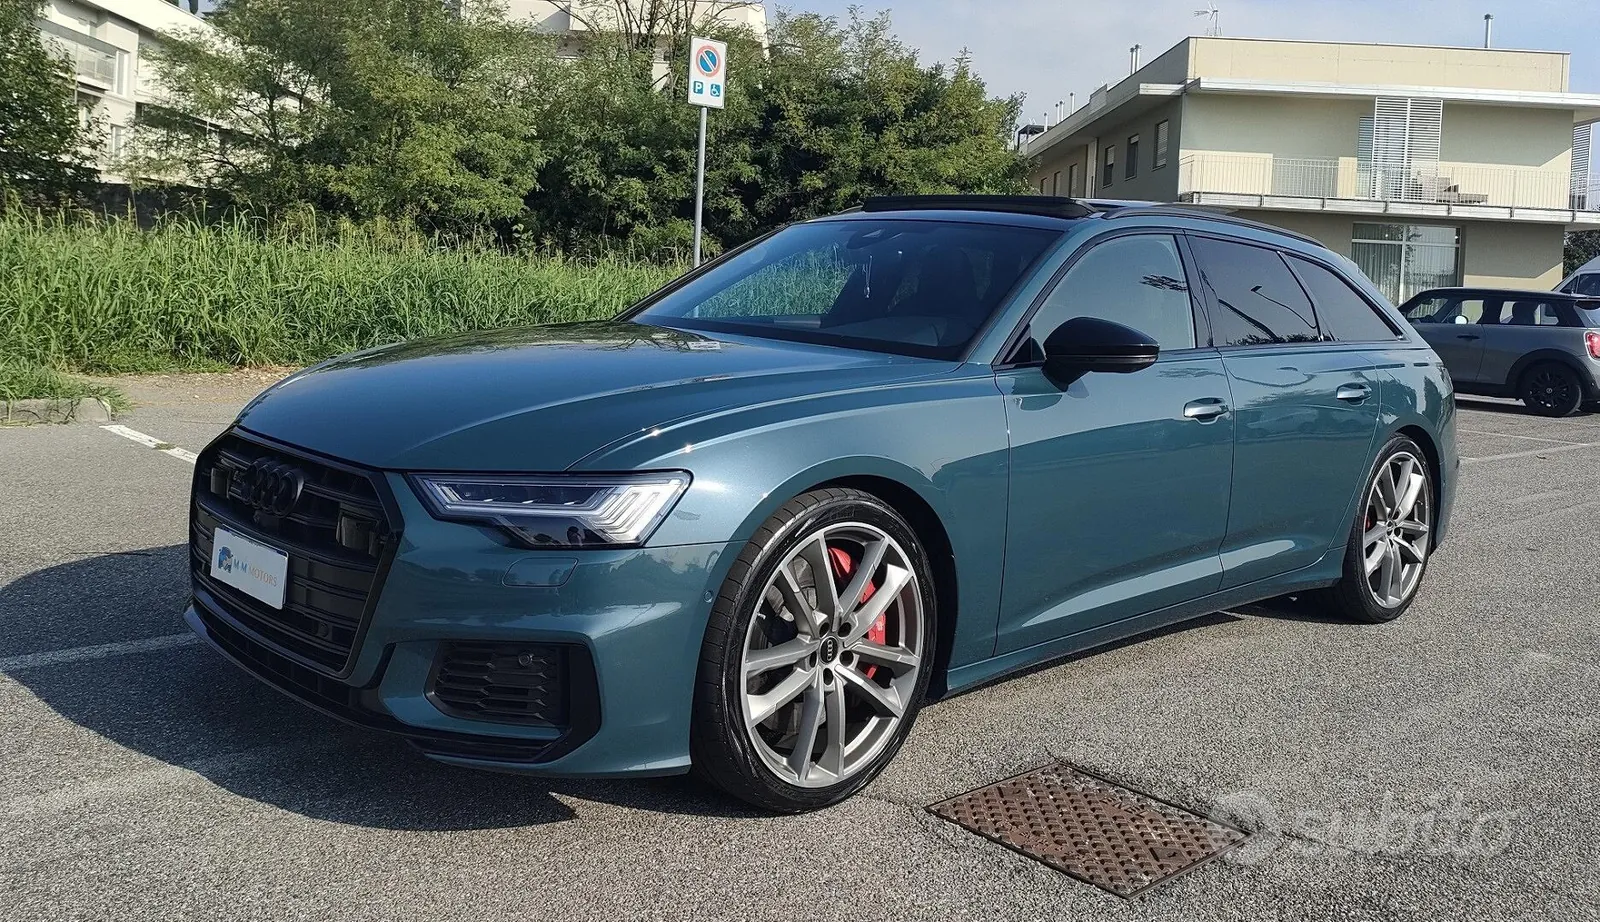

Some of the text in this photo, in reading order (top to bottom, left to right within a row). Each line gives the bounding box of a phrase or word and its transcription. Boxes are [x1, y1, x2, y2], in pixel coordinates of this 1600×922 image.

[695, 81, 702, 93] P
[249, 566, 278, 587] MOTORS
[1100, 796, 1147, 818] ENEL
